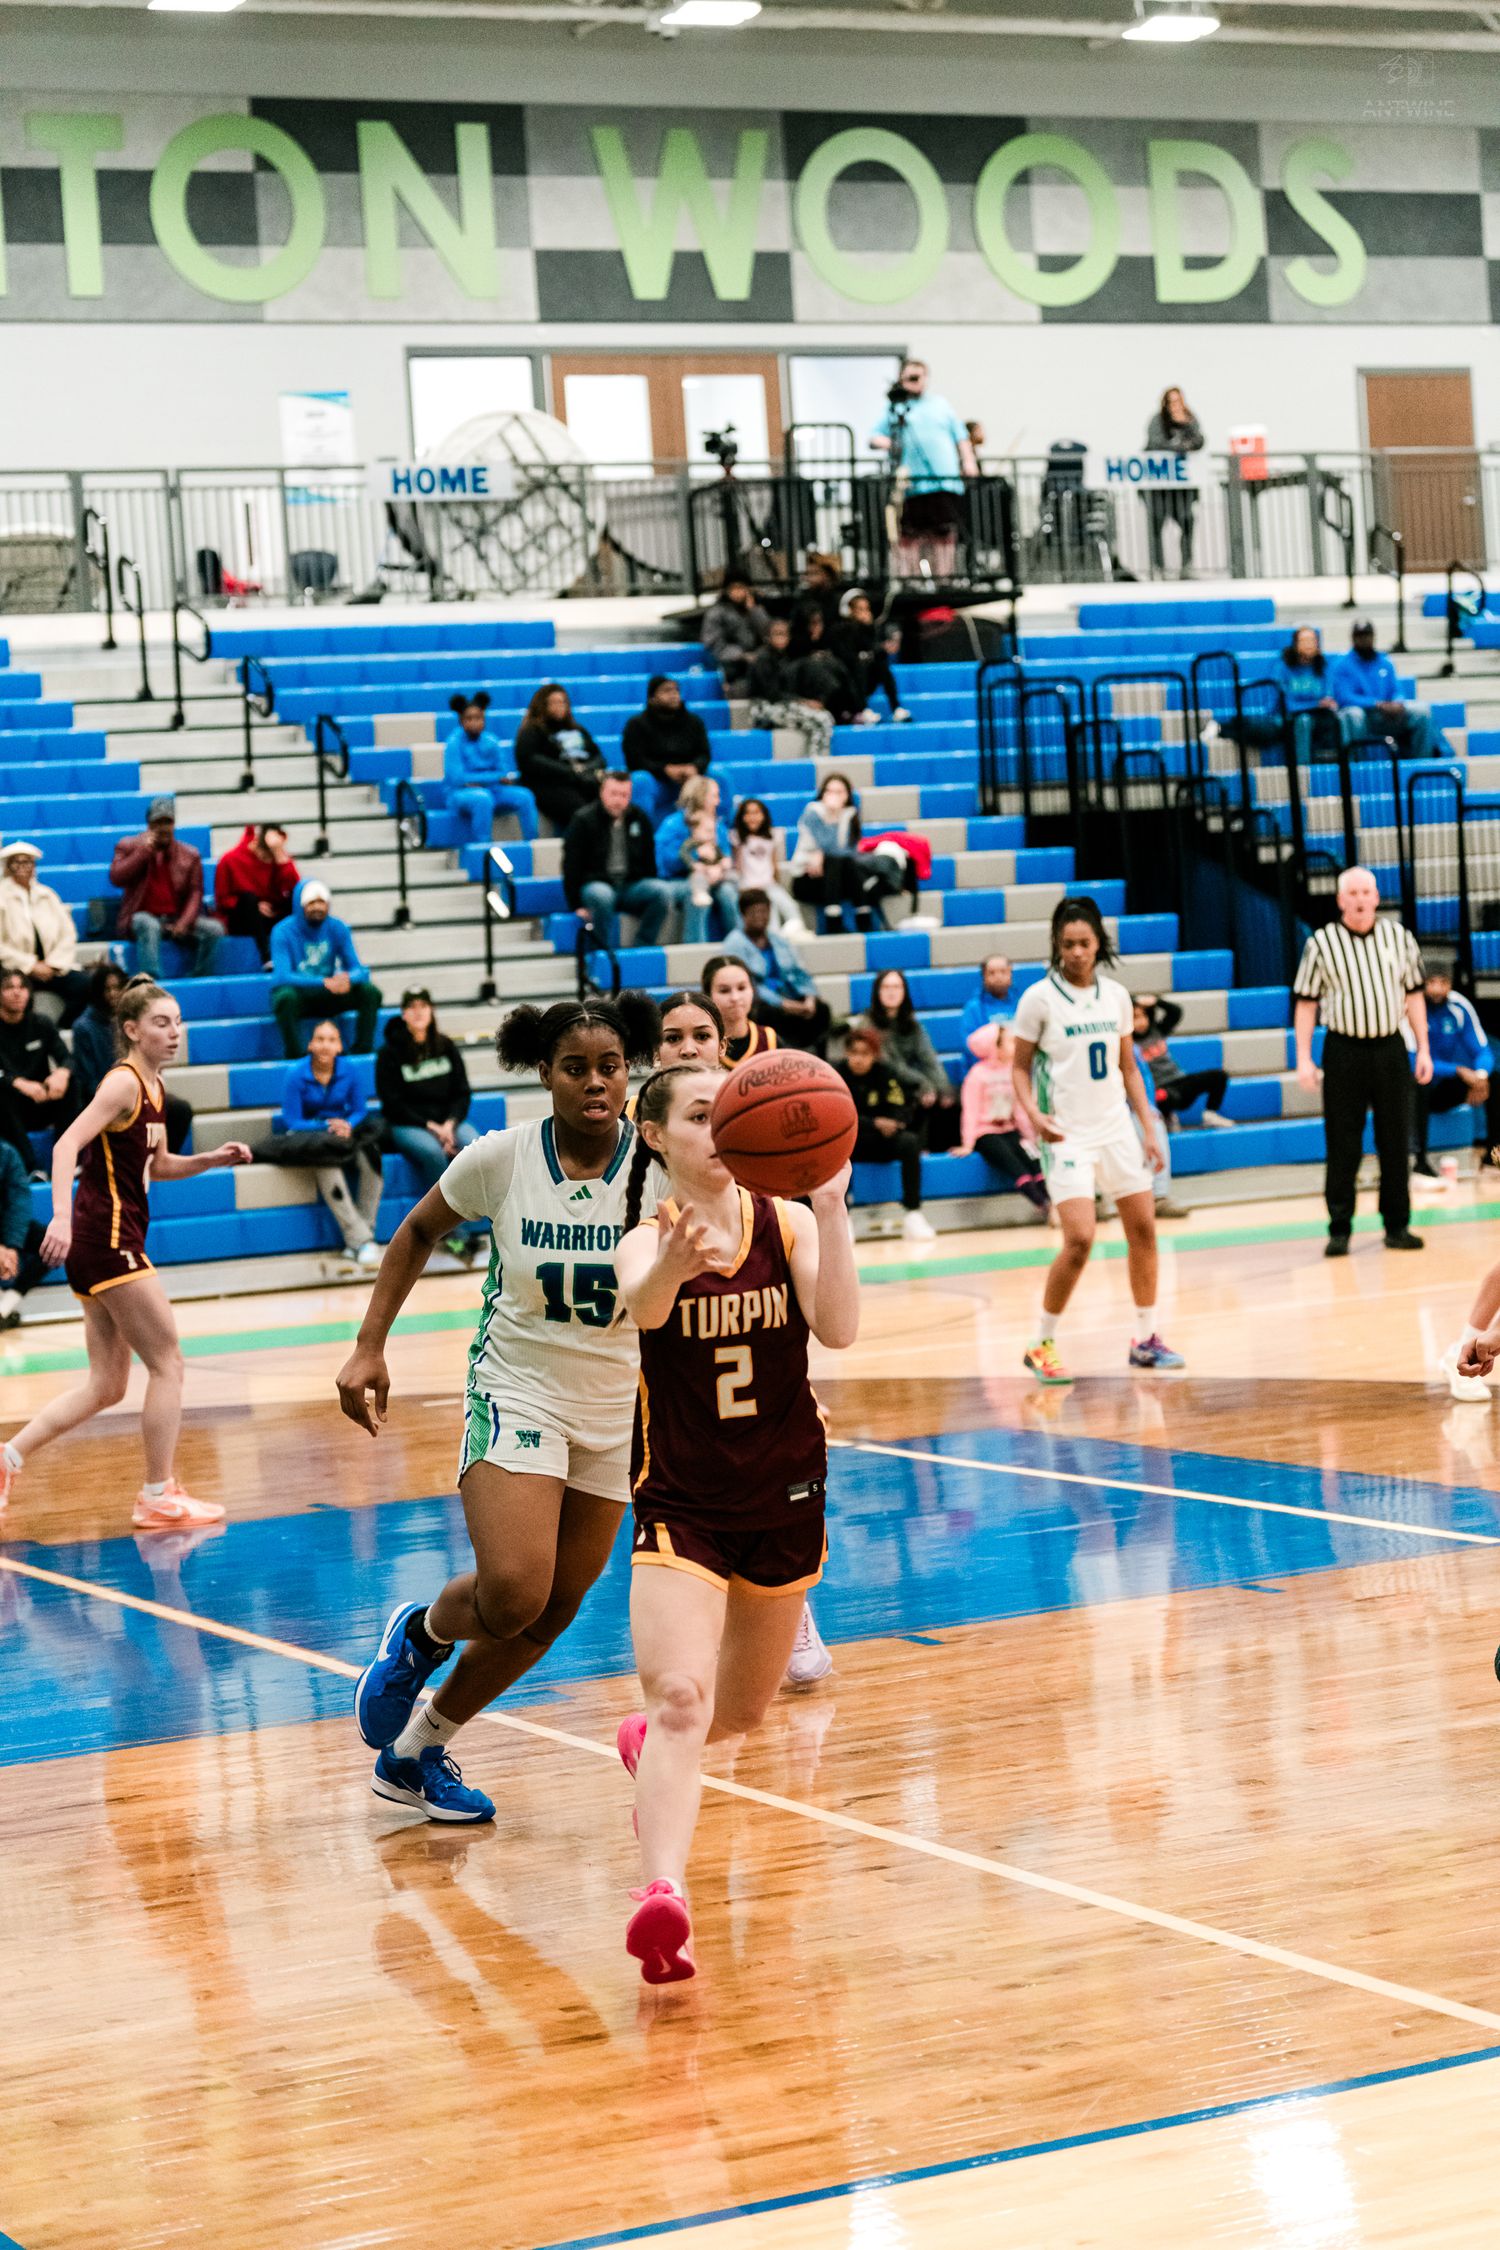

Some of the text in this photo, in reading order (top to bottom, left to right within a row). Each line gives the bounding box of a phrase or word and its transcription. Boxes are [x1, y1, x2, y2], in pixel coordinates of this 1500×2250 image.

[0, 112, 1368, 307] TON WOODS
[392, 467, 489, 494] HOME
[1106, 455, 1188, 482] HOME
[1089, 1042, 1107, 1080] 0
[535, 1262, 619, 1329] 15
[677, 1282, 789, 1341] TURPIN
[713, 1344, 758, 1420] 2
